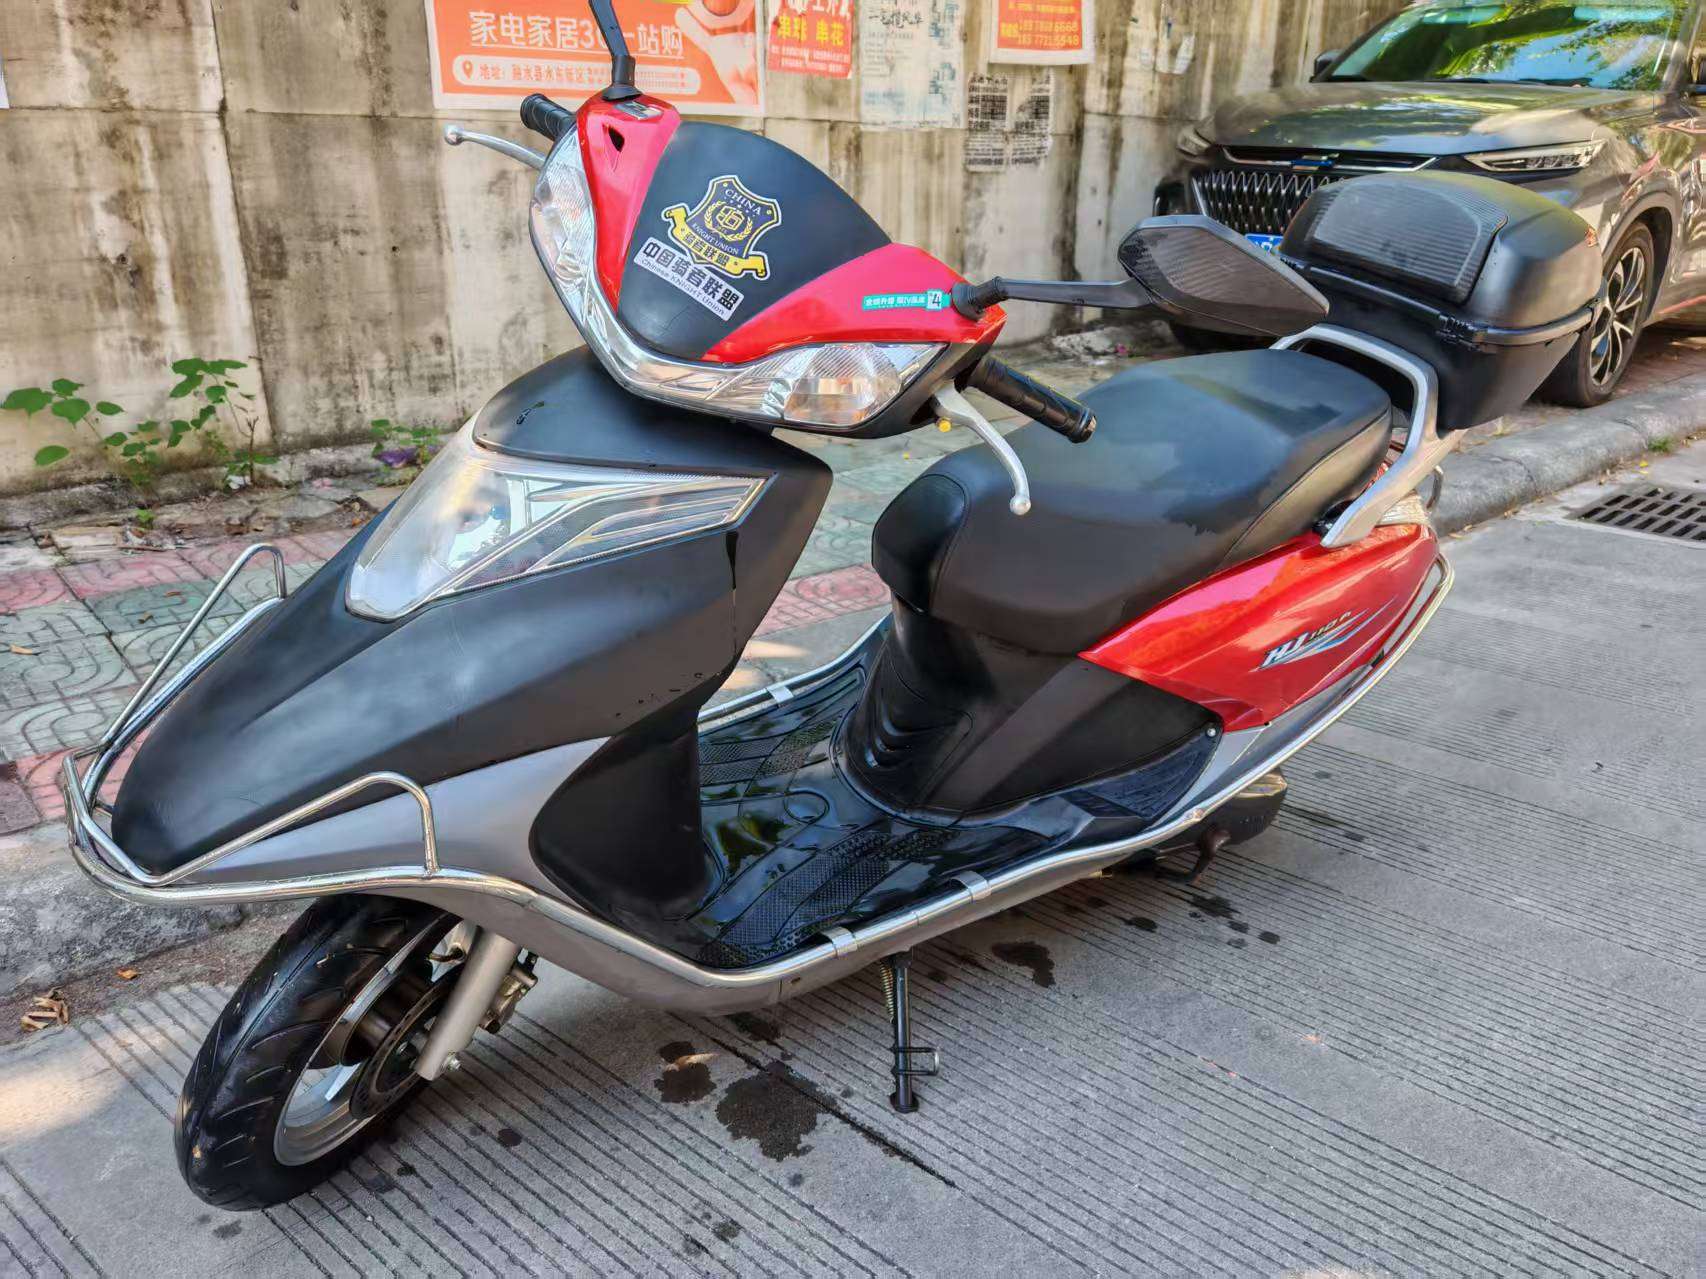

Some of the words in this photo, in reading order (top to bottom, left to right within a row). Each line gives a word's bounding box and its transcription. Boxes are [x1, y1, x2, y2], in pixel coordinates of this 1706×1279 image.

[468, 10, 684, 56] 家电家居3一站购
[724, 188, 763, 216] CHINA
[714, 239, 740, 256] UNION
[642, 241, 740, 311] 中国骑者联盟
